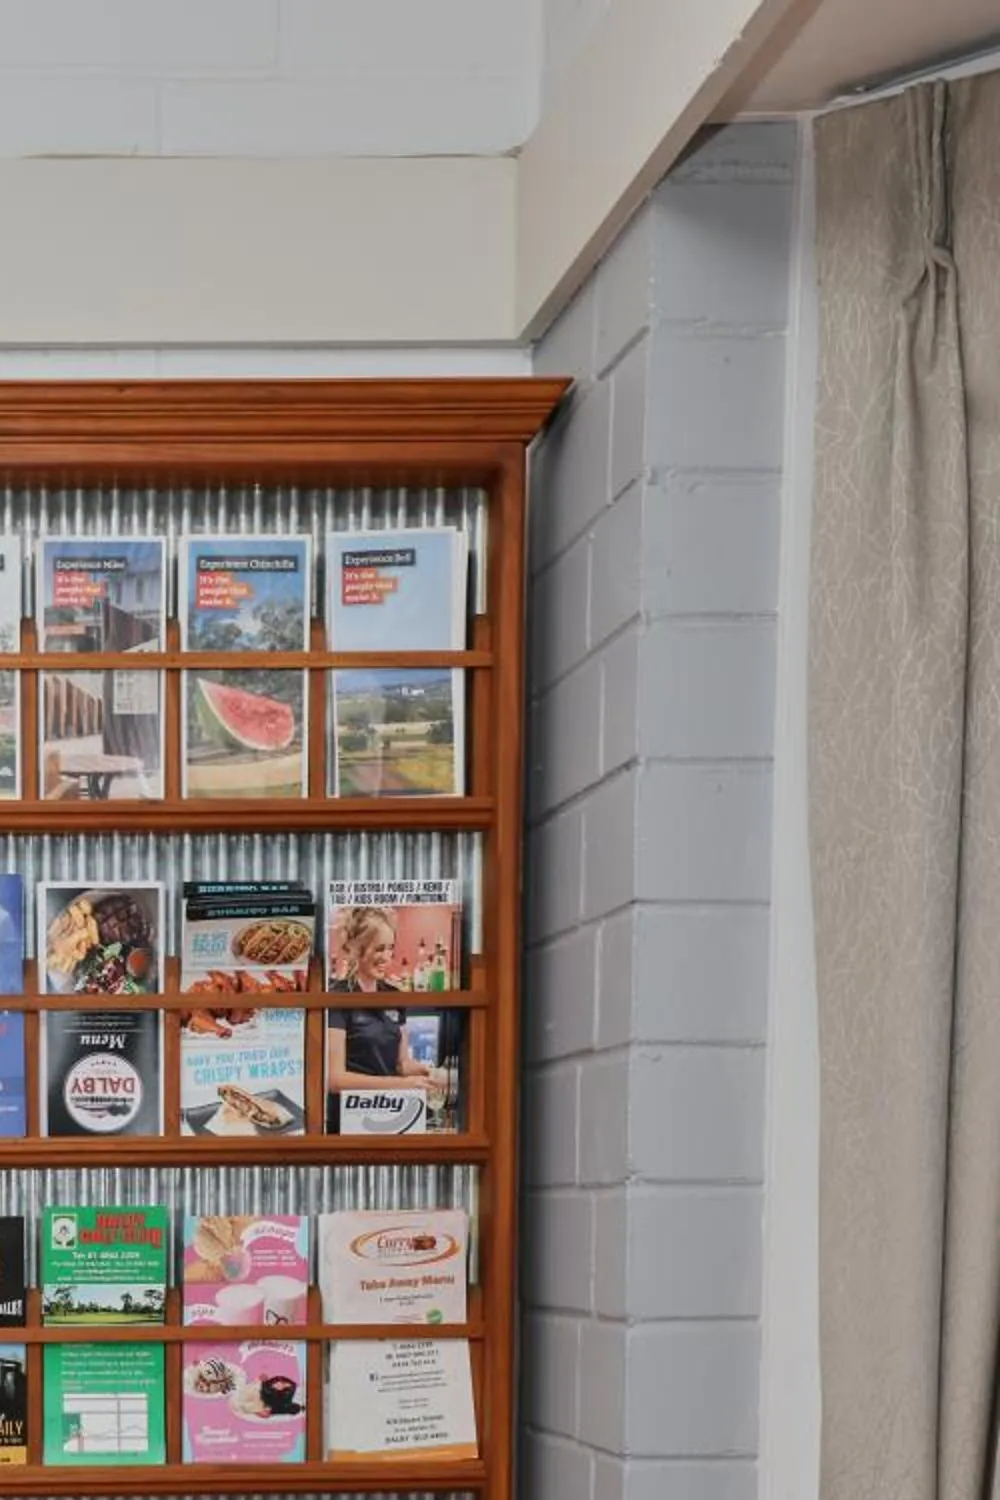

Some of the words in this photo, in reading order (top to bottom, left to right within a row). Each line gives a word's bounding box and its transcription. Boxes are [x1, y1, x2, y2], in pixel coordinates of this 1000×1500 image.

[56, 560, 101, 570] Experience
[200, 560, 248, 571] Experience
[345, 554, 393, 566] Experience
[80, 1033, 127, 1049] Menu
[193, 1065, 242, 1084] CRISPY
[71, 1077, 136, 1095] DALBY
[345, 1094, 405, 1113] Dalby
[360, 1279, 387, 1292] Take
